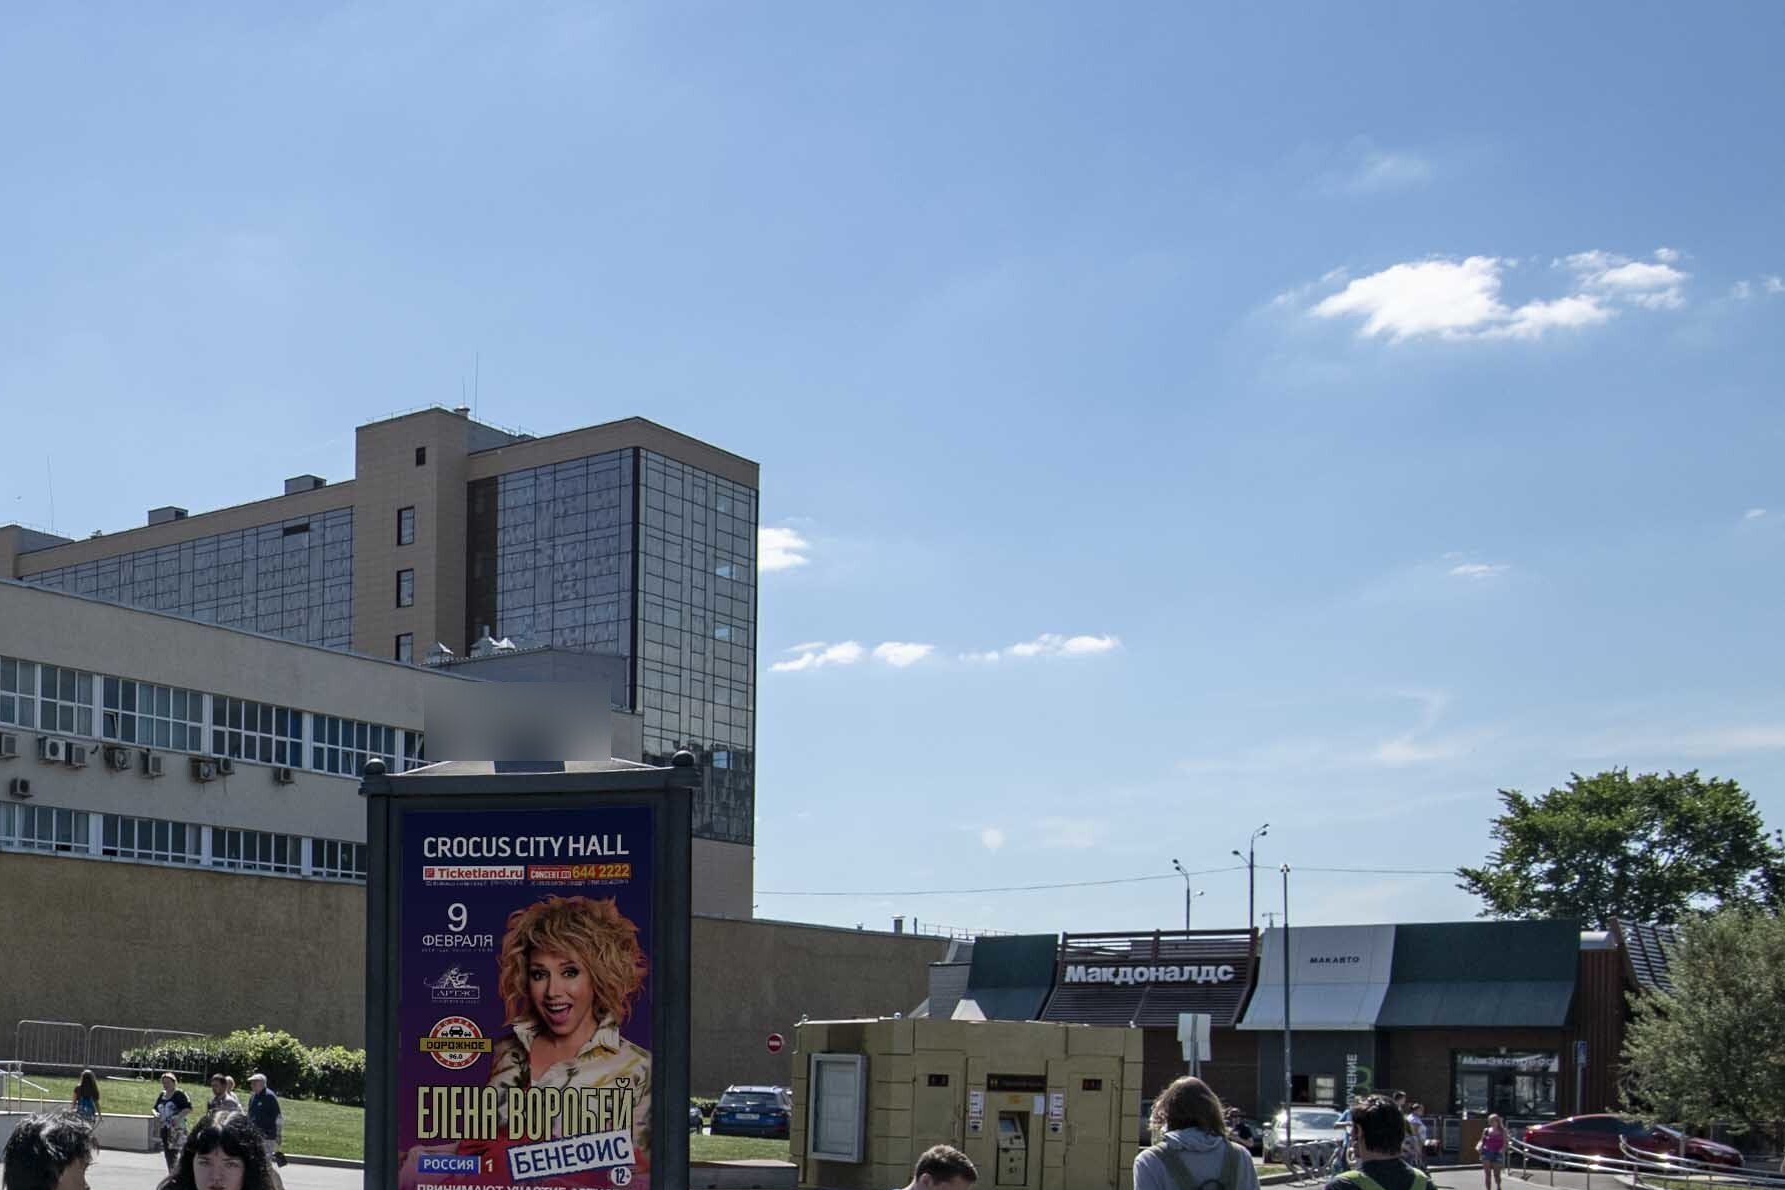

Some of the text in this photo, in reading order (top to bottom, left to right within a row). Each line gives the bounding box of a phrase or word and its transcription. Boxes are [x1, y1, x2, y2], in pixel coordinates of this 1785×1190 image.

[423, 833, 630, 858] CROCUS CITY HALL
[437, 867, 524, 879] Ticketland.ru
[572, 865, 596, 879] 644
[599, 863, 630, 878] 2222
[447, 902, 468, 932] 9
[421, 934, 494, 948] ФЕВРАЛЯ
[1064, 965, 1235, 985] Макдоналдс
[426, 1041, 486, 1050] ДОРОЖНОЕ
[417, 1077, 634, 1142] ЕЛЕНА ВОРОБЕЙ
[513, 1136, 630, 1175] БЕНЕФИС
[423, 1158, 494, 1172] РОССИЯ 1
